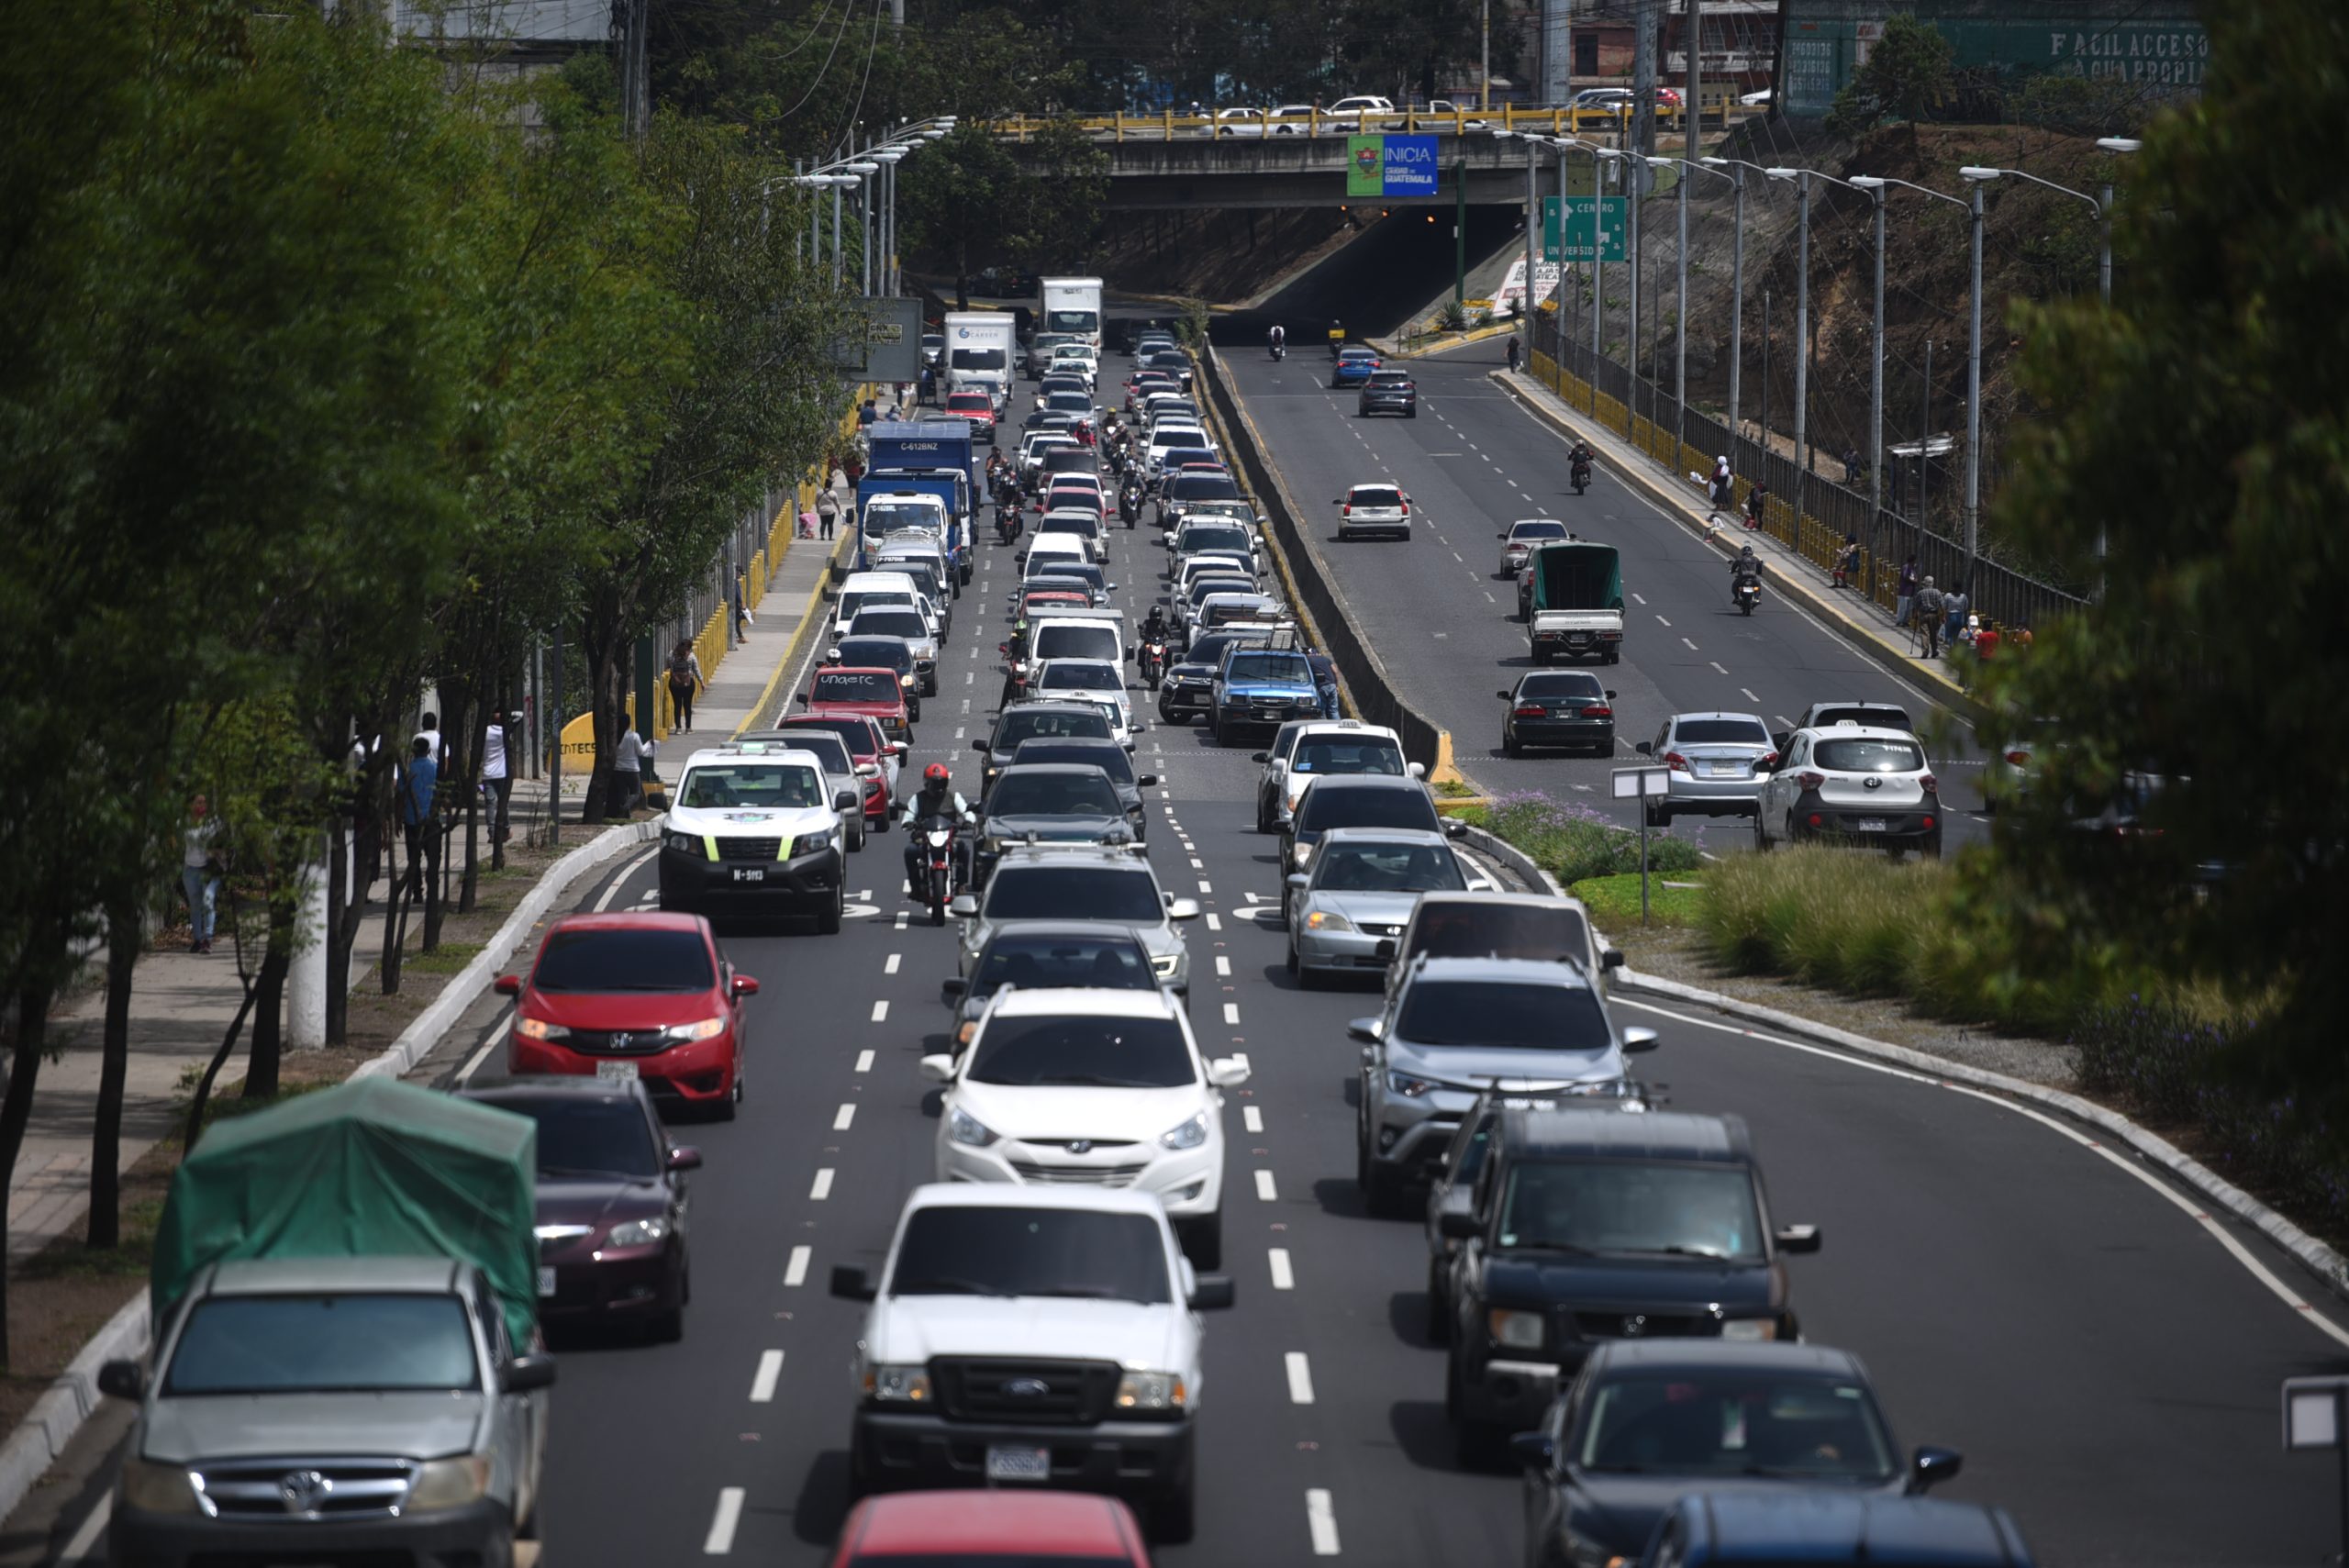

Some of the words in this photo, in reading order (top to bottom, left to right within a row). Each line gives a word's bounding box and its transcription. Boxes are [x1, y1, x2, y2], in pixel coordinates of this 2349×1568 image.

[2129, 33, 2209, 57] ACCESO
[1385, 147, 1431, 162] INICIA
[1385, 174, 1433, 183] GUATEMALA
[1576, 203, 1615, 213] CENRO
[1547, 245, 1606, 256] UNVERSIDD
